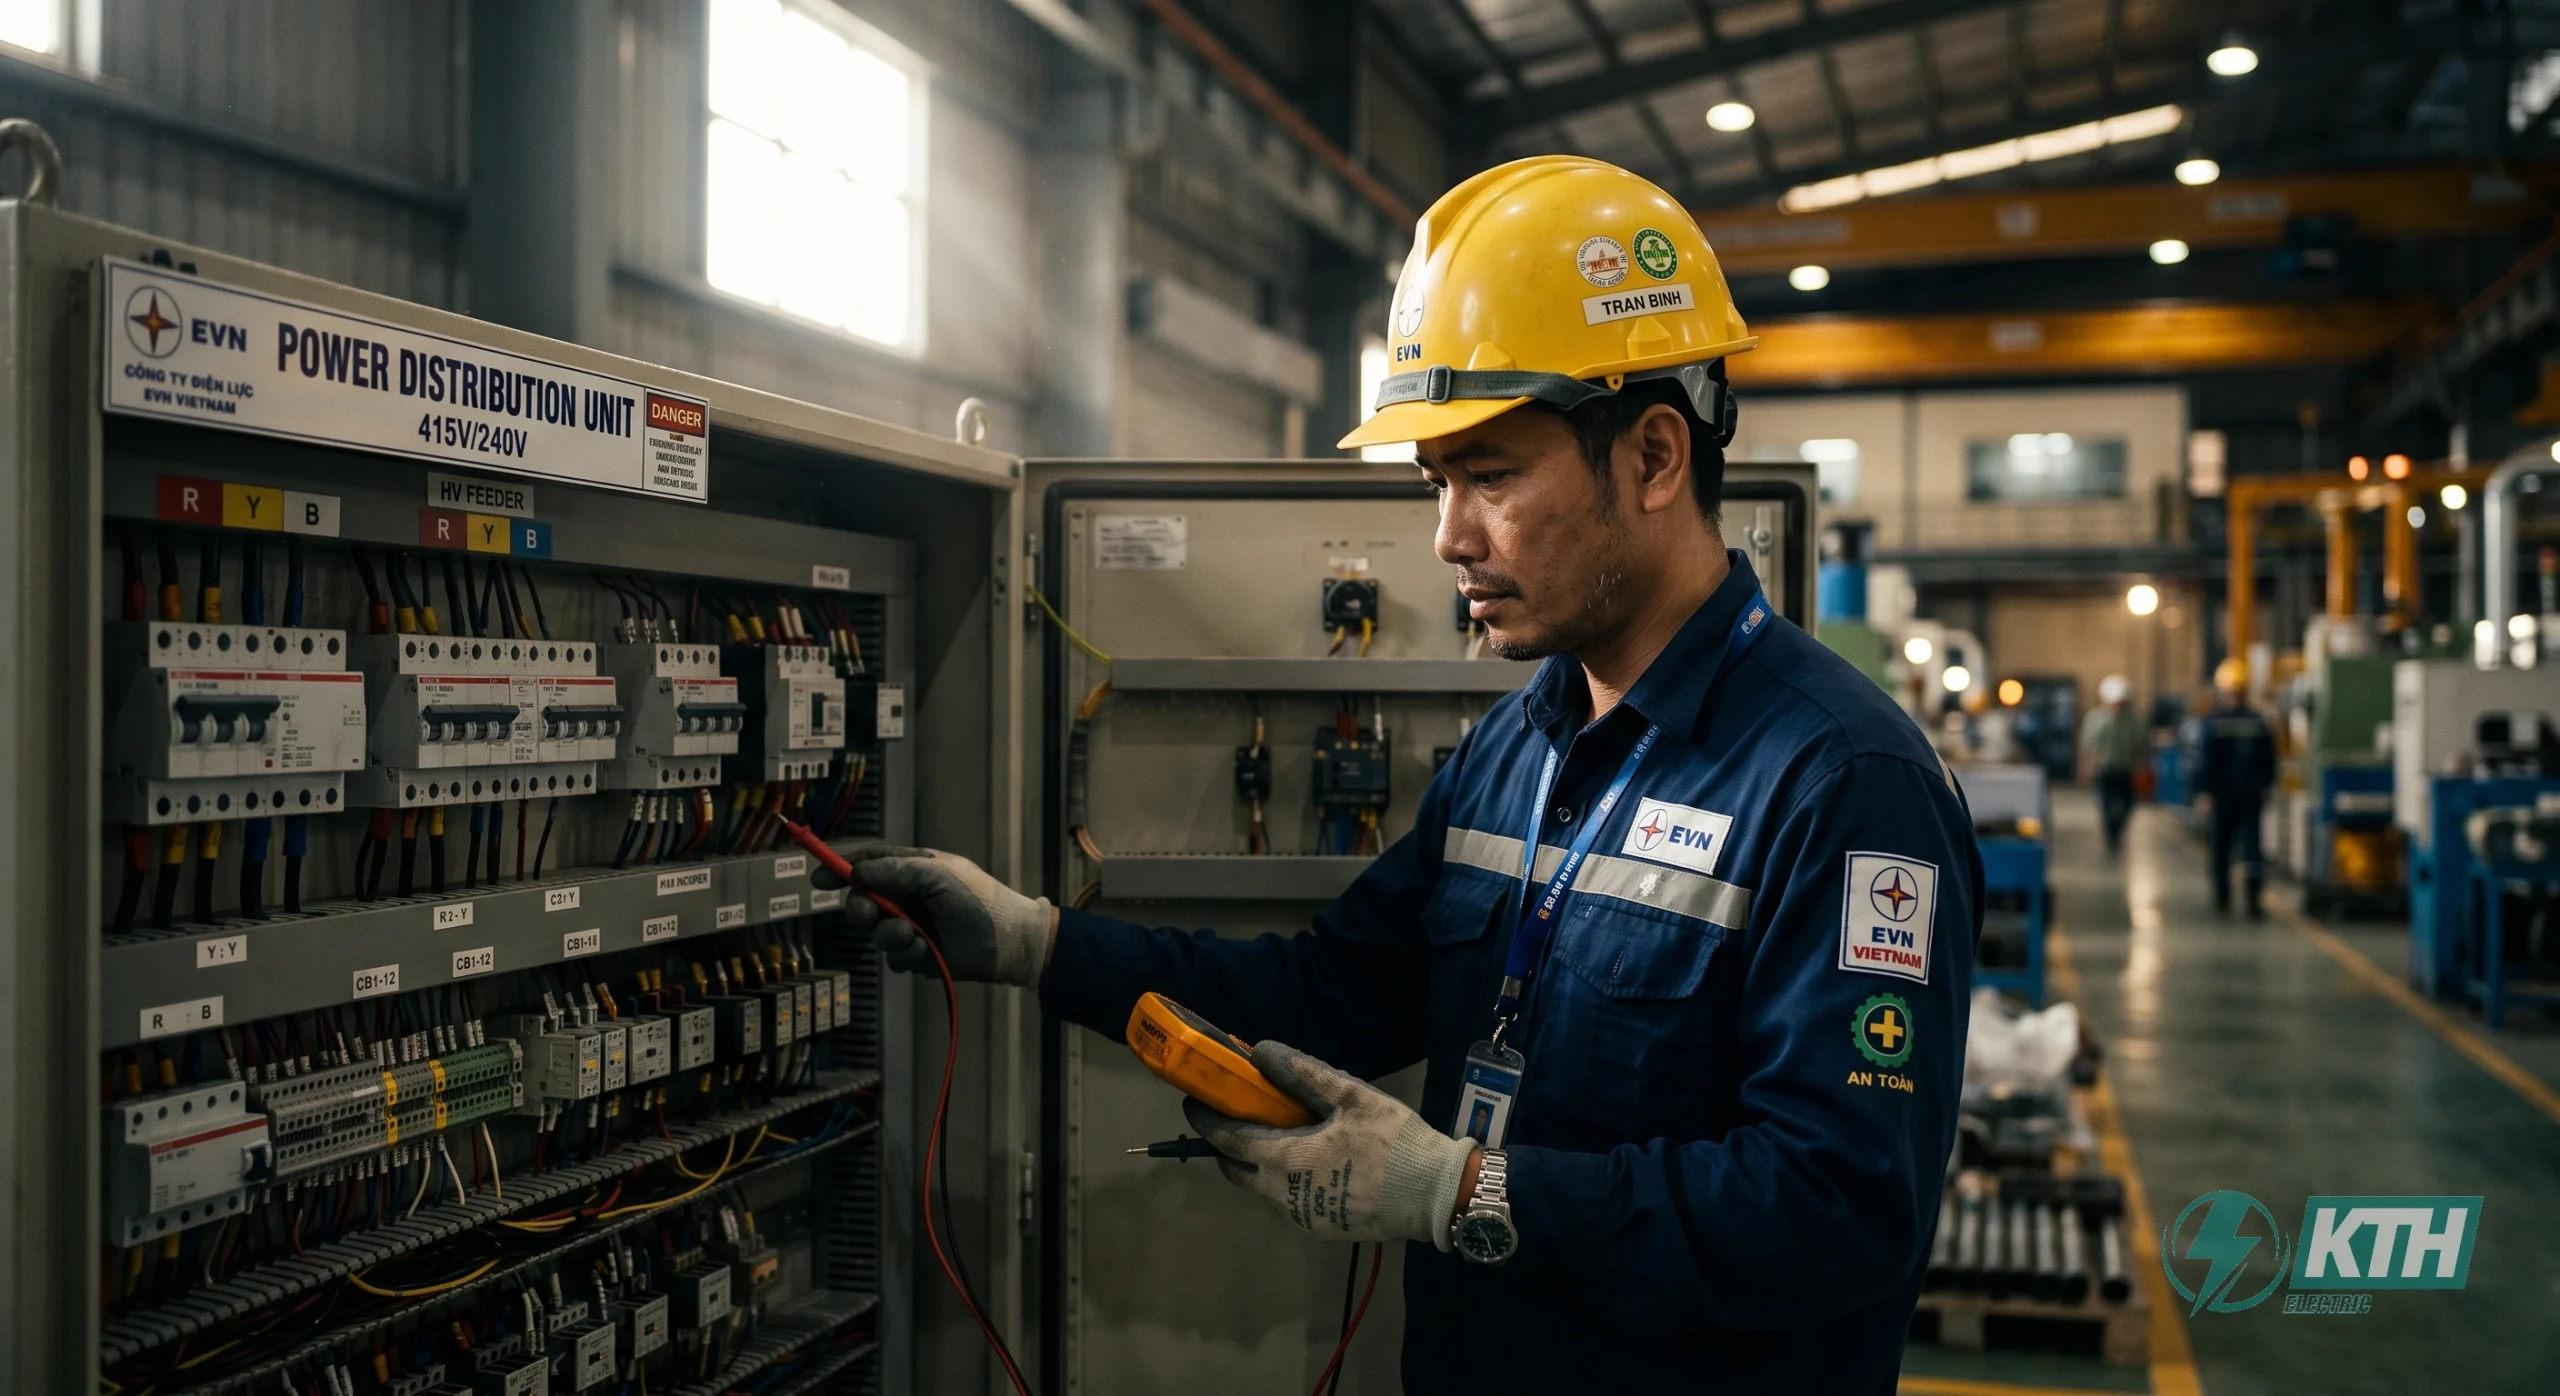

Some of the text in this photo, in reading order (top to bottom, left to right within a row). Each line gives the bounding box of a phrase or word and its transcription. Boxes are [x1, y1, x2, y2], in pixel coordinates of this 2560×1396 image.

[1601, 290, 1682, 316] TRAN BINH
[191, 317, 247, 352] EVN
[1396, 343, 1421, 363] EVN
[124, 363, 166, 382] CÔNG
[170, 371, 187, 386] TY
[191, 375, 224, 394] ĐIỆN
[278, 321, 635, 438] POWER DISTRIBUTION UNIT
[144, 387, 236, 415] EVN VIETNAM
[651, 403, 702, 428] DANGER
[418, 412, 528, 458] 415V/240V
[182, 487, 320, 526] R Y B
[440, 480, 525, 511] HV FEEDER
[437, 518, 538, 549] R Y B
[1668, 824, 1714, 851] EVN
[1871, 926, 1914, 949] EVN
[456, 952, 491, 971] CB1-12
[1853, 945, 1922, 970] VIETNAM
[356, 971, 396, 991] CB1-12
[152, 1013, 164, 1029] R
[201, 1004, 212, 1020] B
[1847, 1070, 1914, 1094] AN TOÀN
